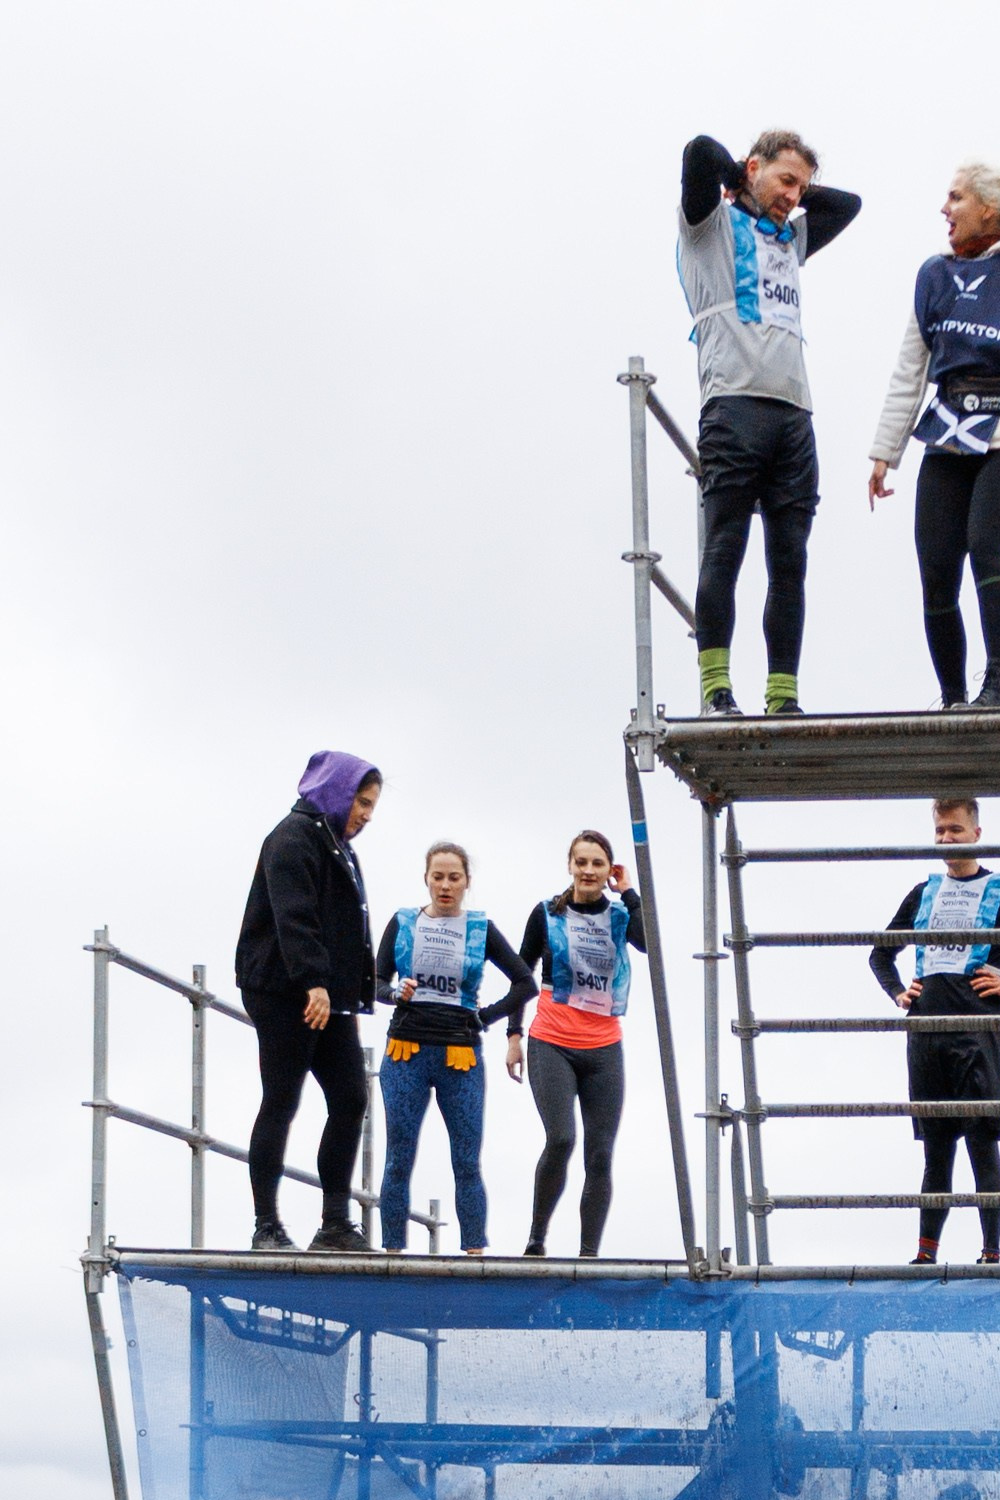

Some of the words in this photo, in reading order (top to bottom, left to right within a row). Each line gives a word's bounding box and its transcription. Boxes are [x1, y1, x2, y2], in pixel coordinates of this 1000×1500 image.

[763, 279, 799, 308] 5400
[424, 934, 456, 947] Sminex
[416, 973, 457, 994] 5405
[576, 970, 608, 992] 5407
